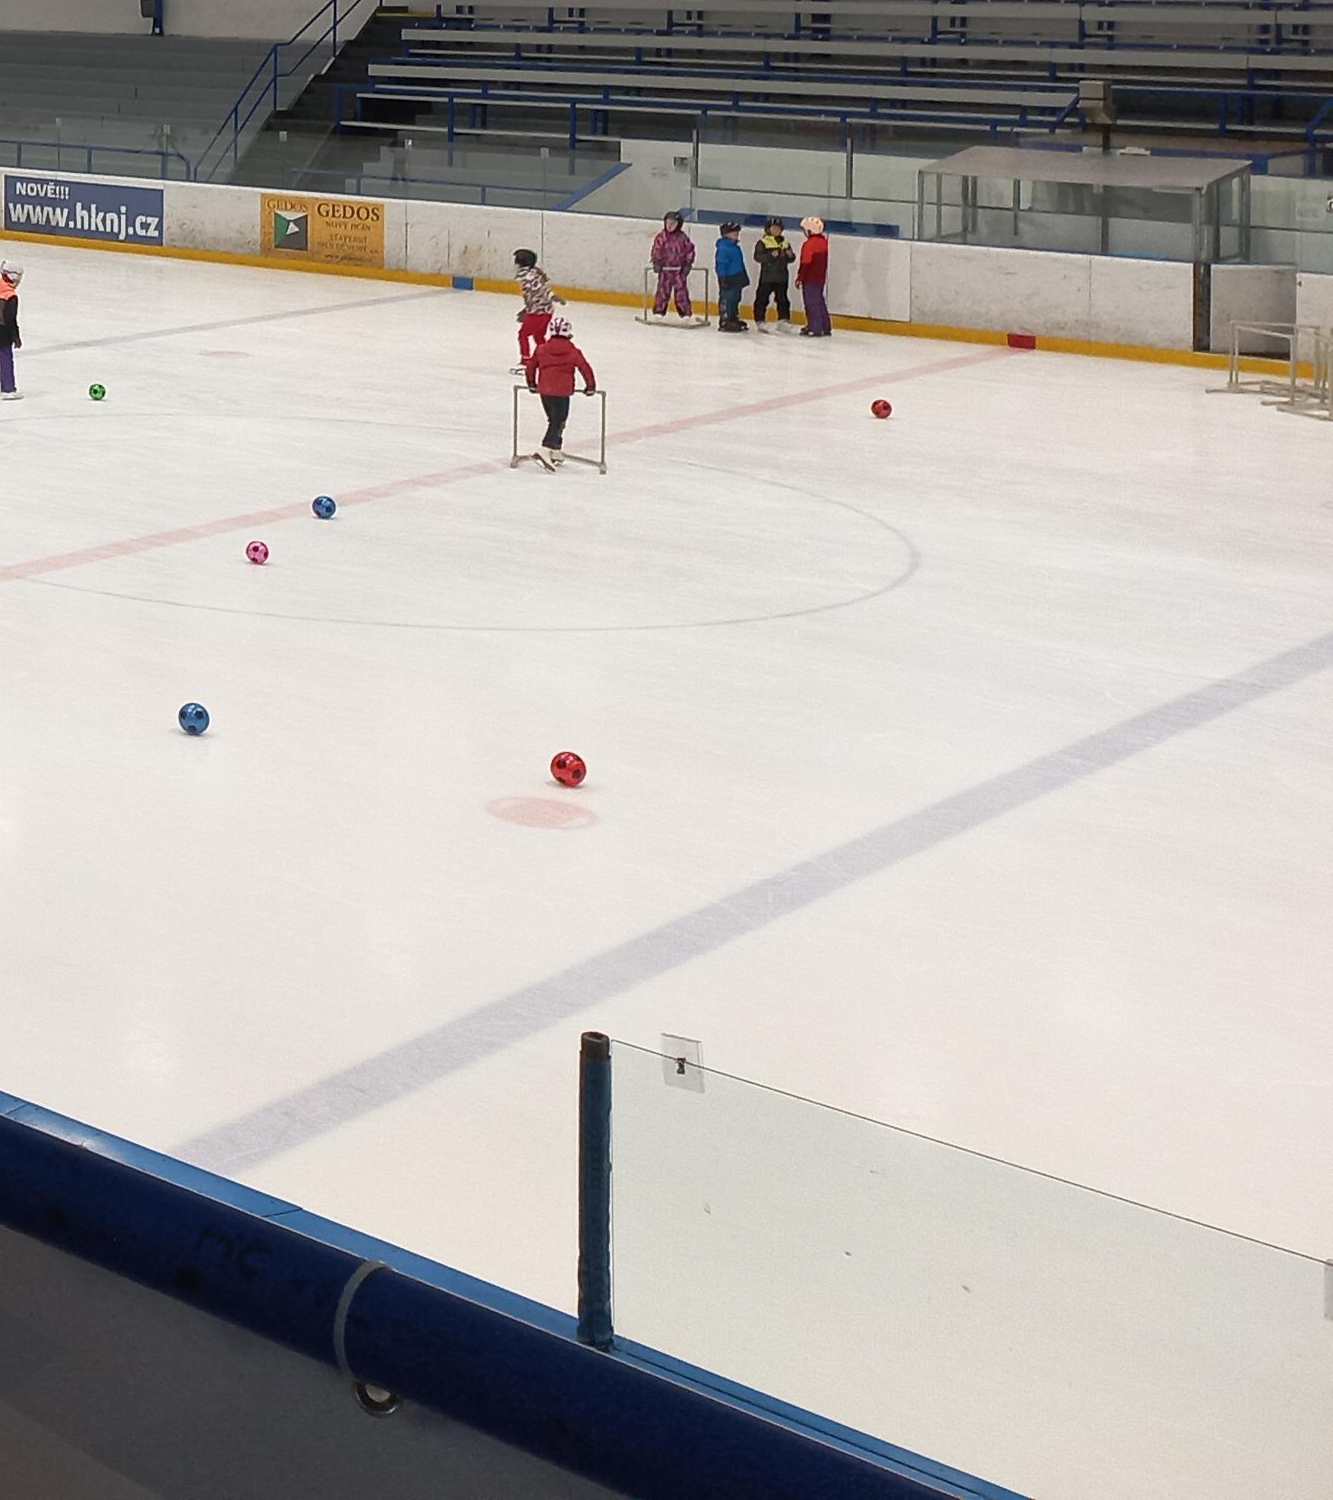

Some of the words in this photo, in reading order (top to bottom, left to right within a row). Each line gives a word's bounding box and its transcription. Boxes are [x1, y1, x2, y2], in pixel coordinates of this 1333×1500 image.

[15, 181, 70, 200] NOVĚ!!!
[7, 201, 160, 241] www.hknj.cz
[317, 202, 381, 222] GEDOS
